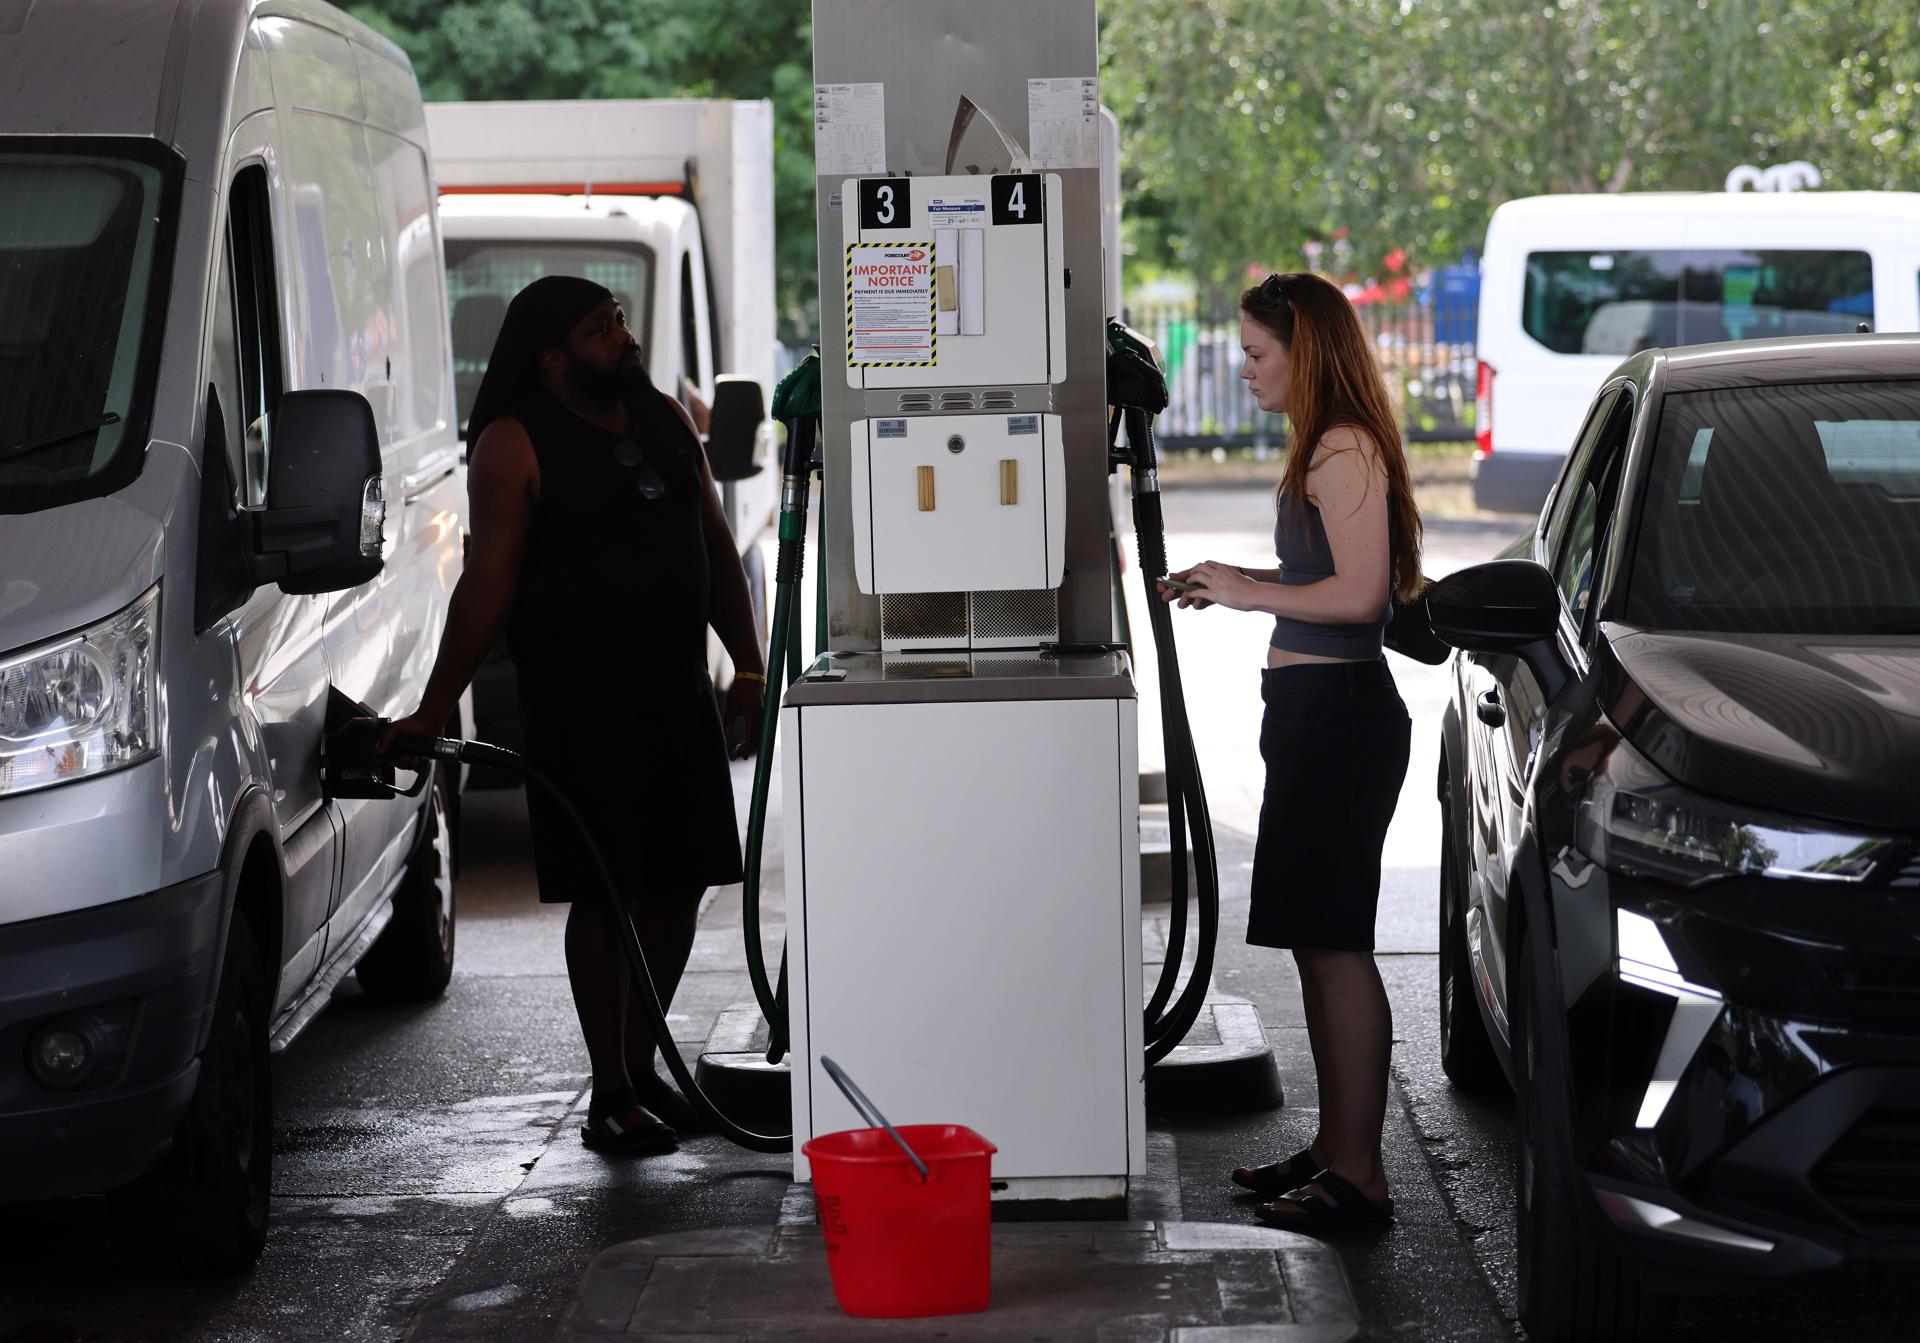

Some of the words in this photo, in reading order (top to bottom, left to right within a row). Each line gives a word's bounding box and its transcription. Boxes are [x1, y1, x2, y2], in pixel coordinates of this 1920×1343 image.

[876, 185, 895, 224] 3
[1008, 181, 1027, 219] 4
[854, 265, 928, 275] IMPORTANT
[868, 276, 914, 286] NOTICE
